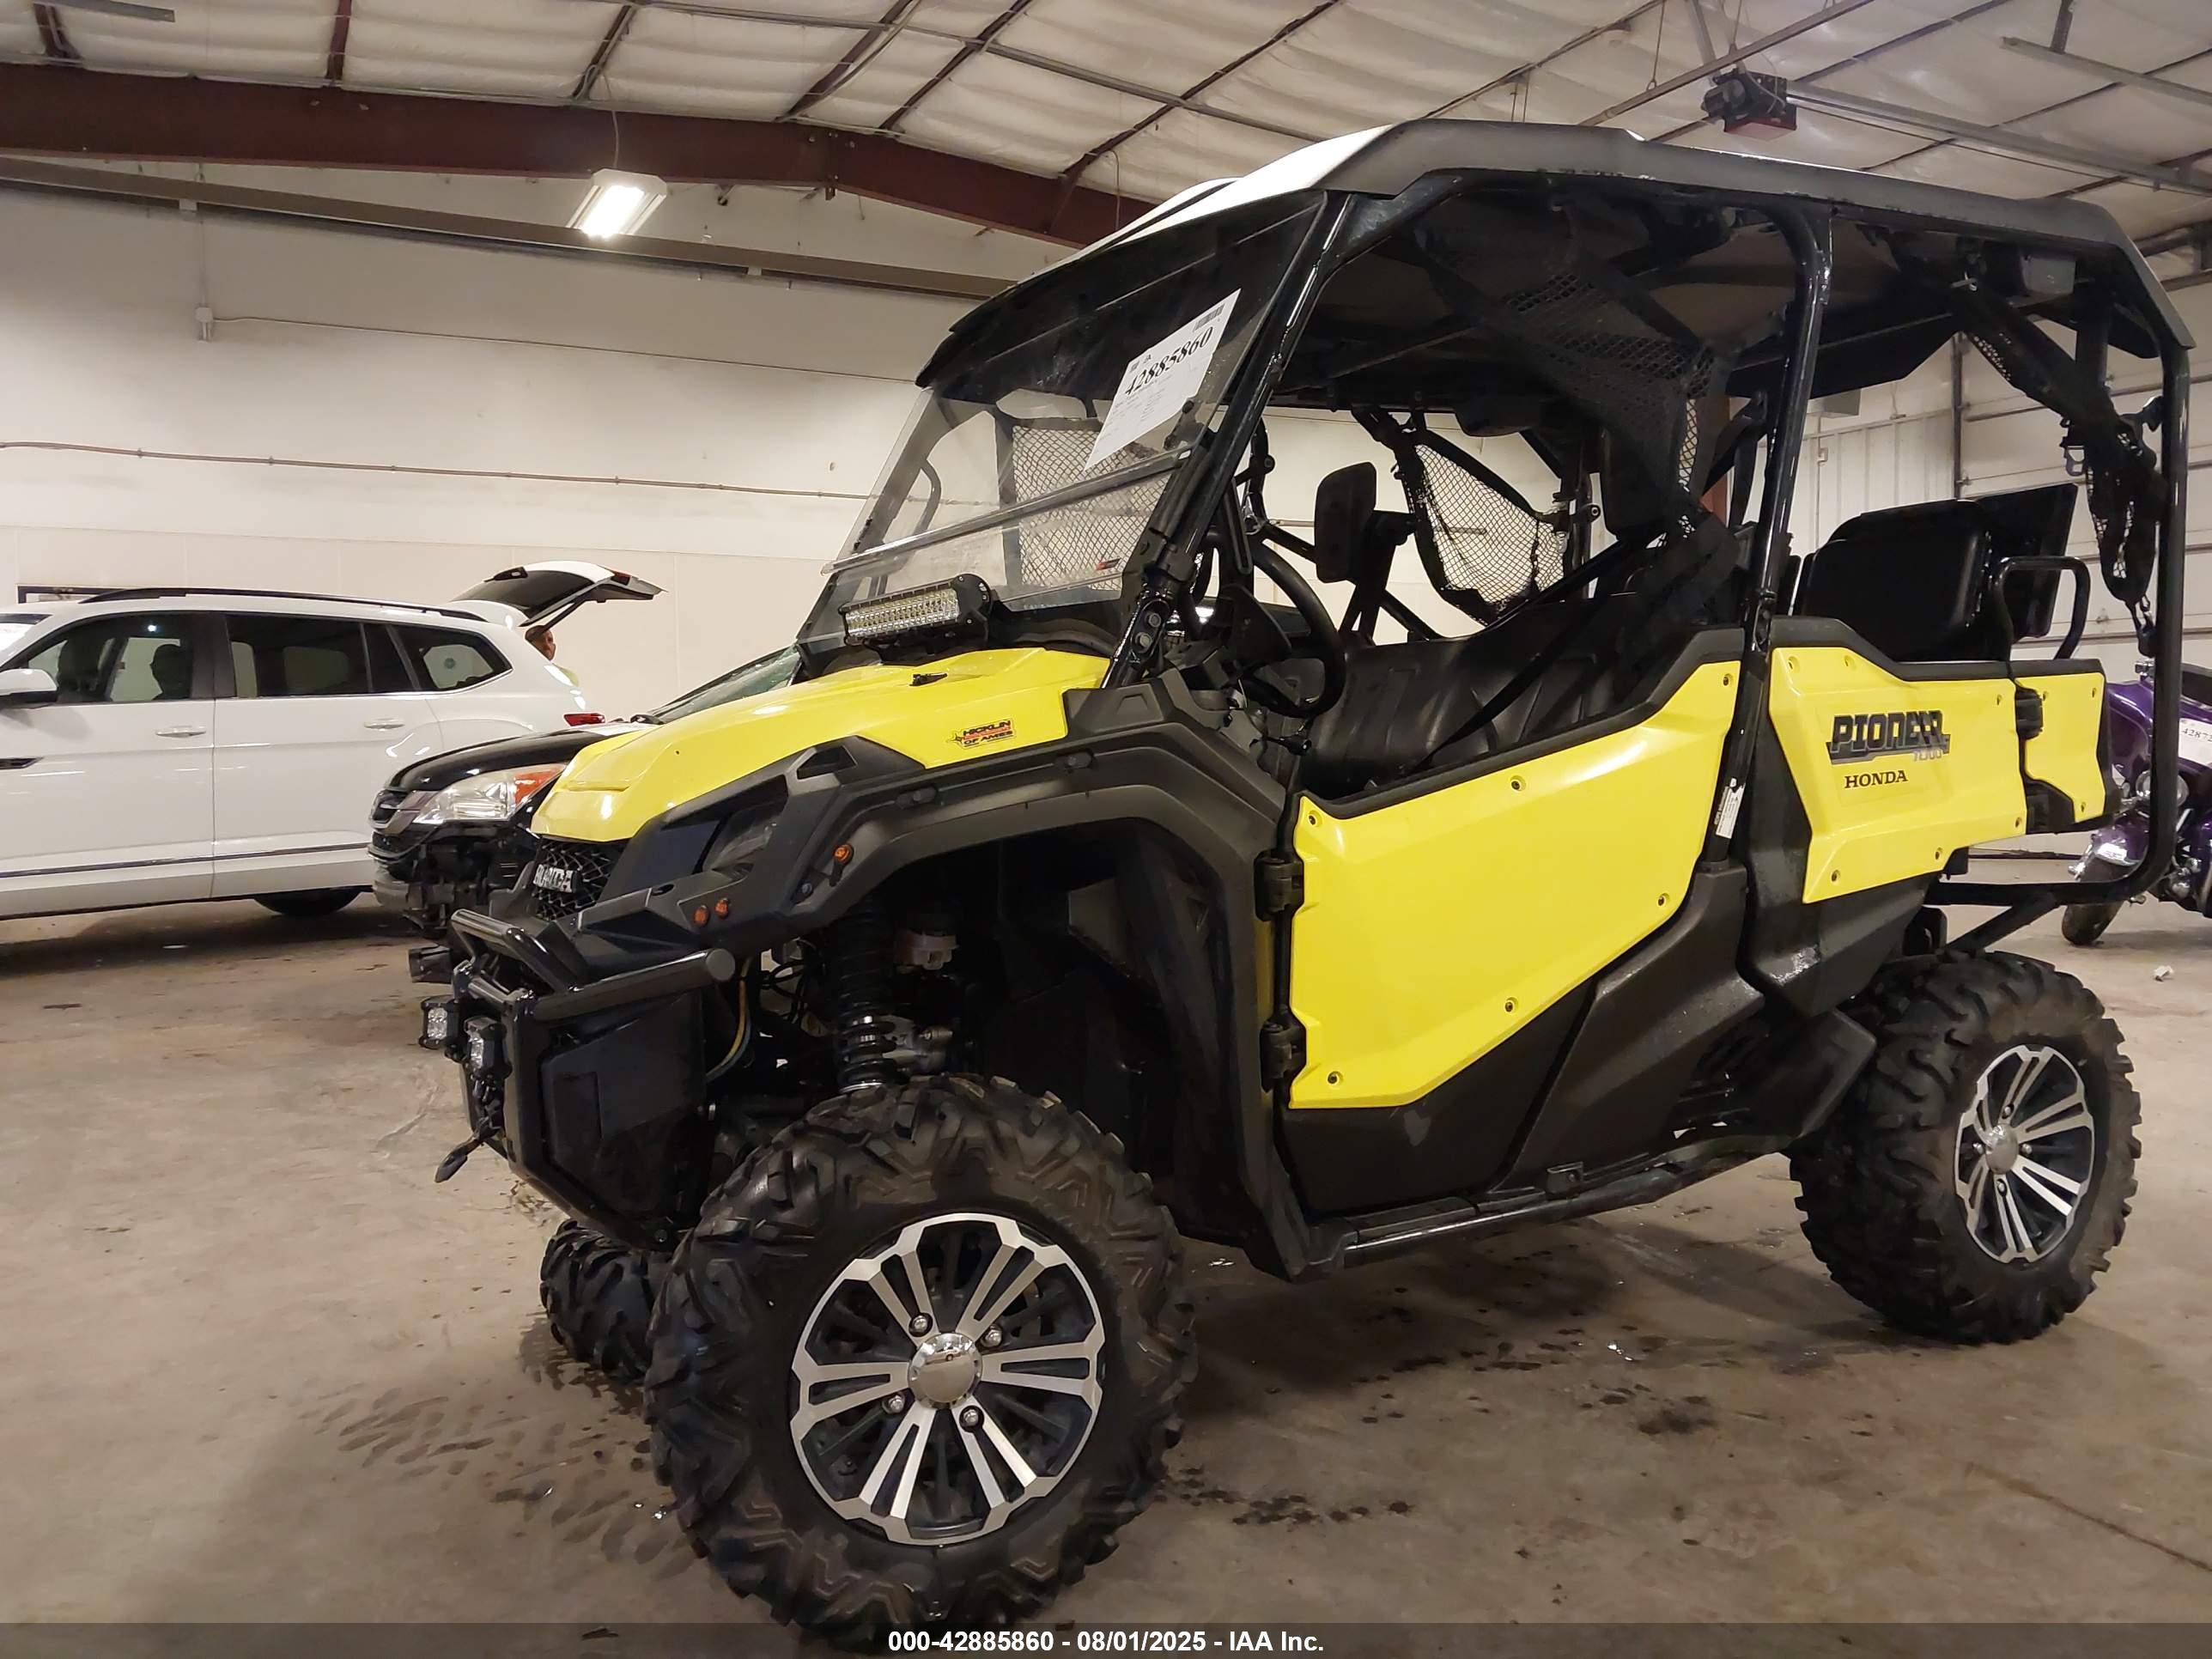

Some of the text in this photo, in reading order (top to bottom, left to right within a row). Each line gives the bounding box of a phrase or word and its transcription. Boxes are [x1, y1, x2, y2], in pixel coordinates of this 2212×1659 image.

[1125, 326, 1213, 395] 42885860
[981, 731, 1013, 741] AMES
[1830, 710, 1944, 754] PIONEER
[1844, 770, 1908, 788] HONDA
